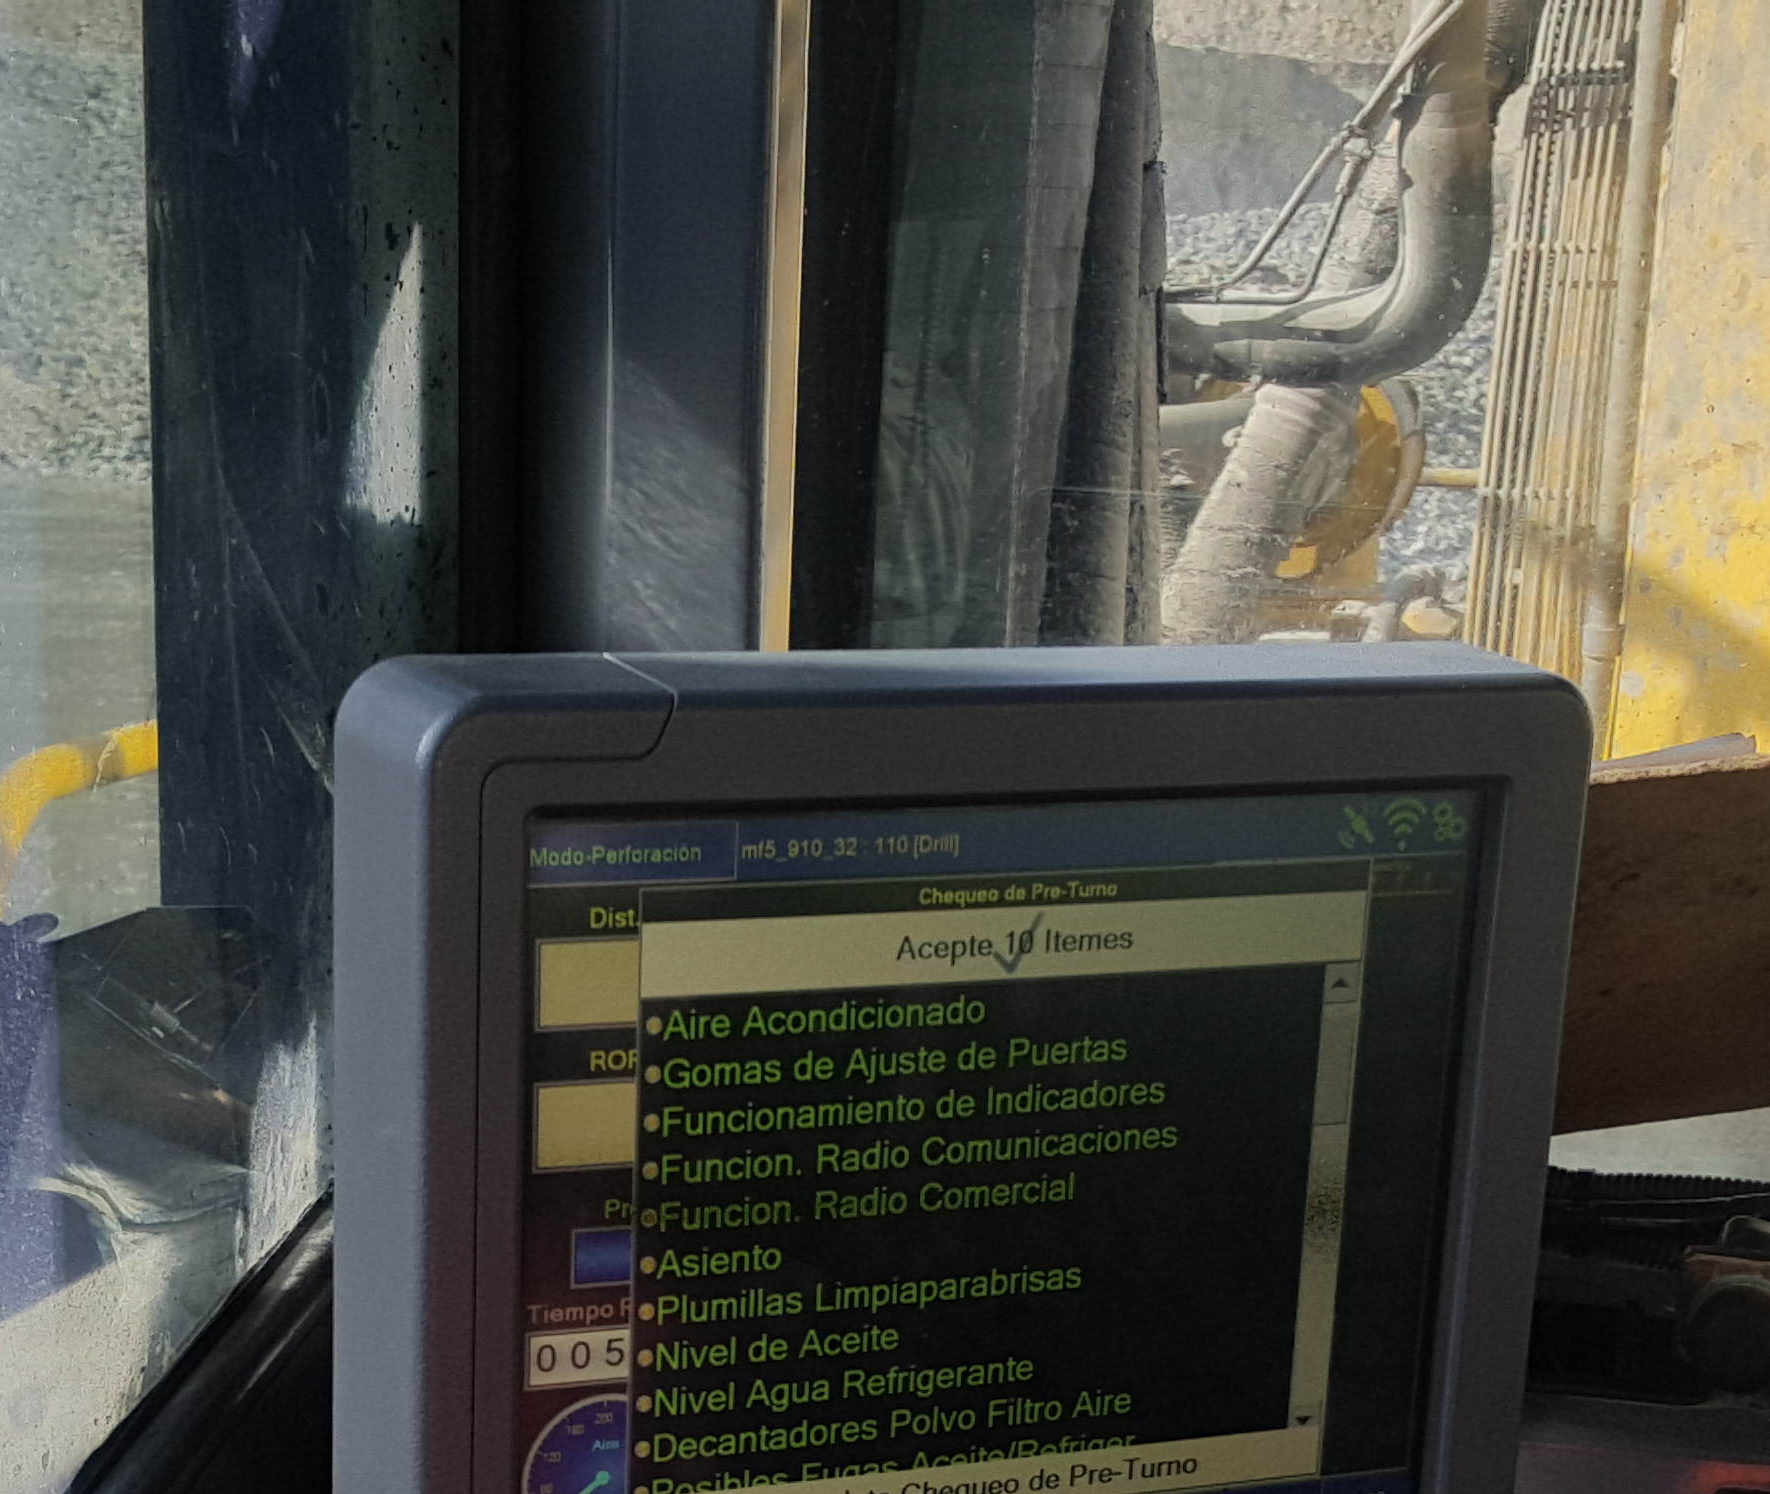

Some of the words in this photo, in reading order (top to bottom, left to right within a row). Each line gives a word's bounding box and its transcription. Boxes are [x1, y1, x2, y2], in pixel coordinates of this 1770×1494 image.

[919, 886, 998, 906] Chequeo
[1004, 883, 1026, 902] de
[896, 933, 994, 966] Acepte
[1006, 929, 1034, 956] 10
[1044, 928, 1134, 954] Itemes
[663, 1009, 731, 1041] Aire
[742, 995, 986, 1038] Acondicionado
[663, 1059, 782, 1090] Gomas
[793, 1053, 833, 1080] de
[846, 1044, 946, 1081] Ajuste
[957, 1040, 997, 1069] de
[1007, 1035, 1128, 1068] Puertas
[661, 1096, 925, 1137] Funcionamiento
[936, 1090, 975, 1120] de
[987, 1079, 1165, 1116] Indicadores
[660, 1149, 803, 1185] Funcion.
[817, 1140, 909, 1174] Radio
[922, 1125, 1178, 1166] Comunicaciones
[659, 1196, 801, 1232] Funcion.
[814, 1186, 907, 1221] Radio
[919, 1172, 1076, 1213] Comercial
[657, 1244, 782, 1279] Asiento
[526, 1303, 614, 1325] Tiempo
[657, 1285, 803, 1326] Plumillas
[815, 1263, 1082, 1312] Limpiaparabrisas
[655, 1335, 736, 1372] Nivel
[748, 1331, 788, 1361] de
[799, 1323, 899, 1358] Aceite
[654, 1381, 735, 1417] Nivel
[746, 1375, 830, 1413] Agua
[842, 1357, 1034, 1401] Refrigerante
[653, 1420, 878, 1463] Decantadores
[890, 1406, 976, 1438] Polvo
[988, 1397, 1063, 1429] Filtro
[1072, 1390, 1132, 1418] Aire
[1029, 1468, 1060, 1492] de
[1070, 1456, 1198, 1487] Pre-Turno
